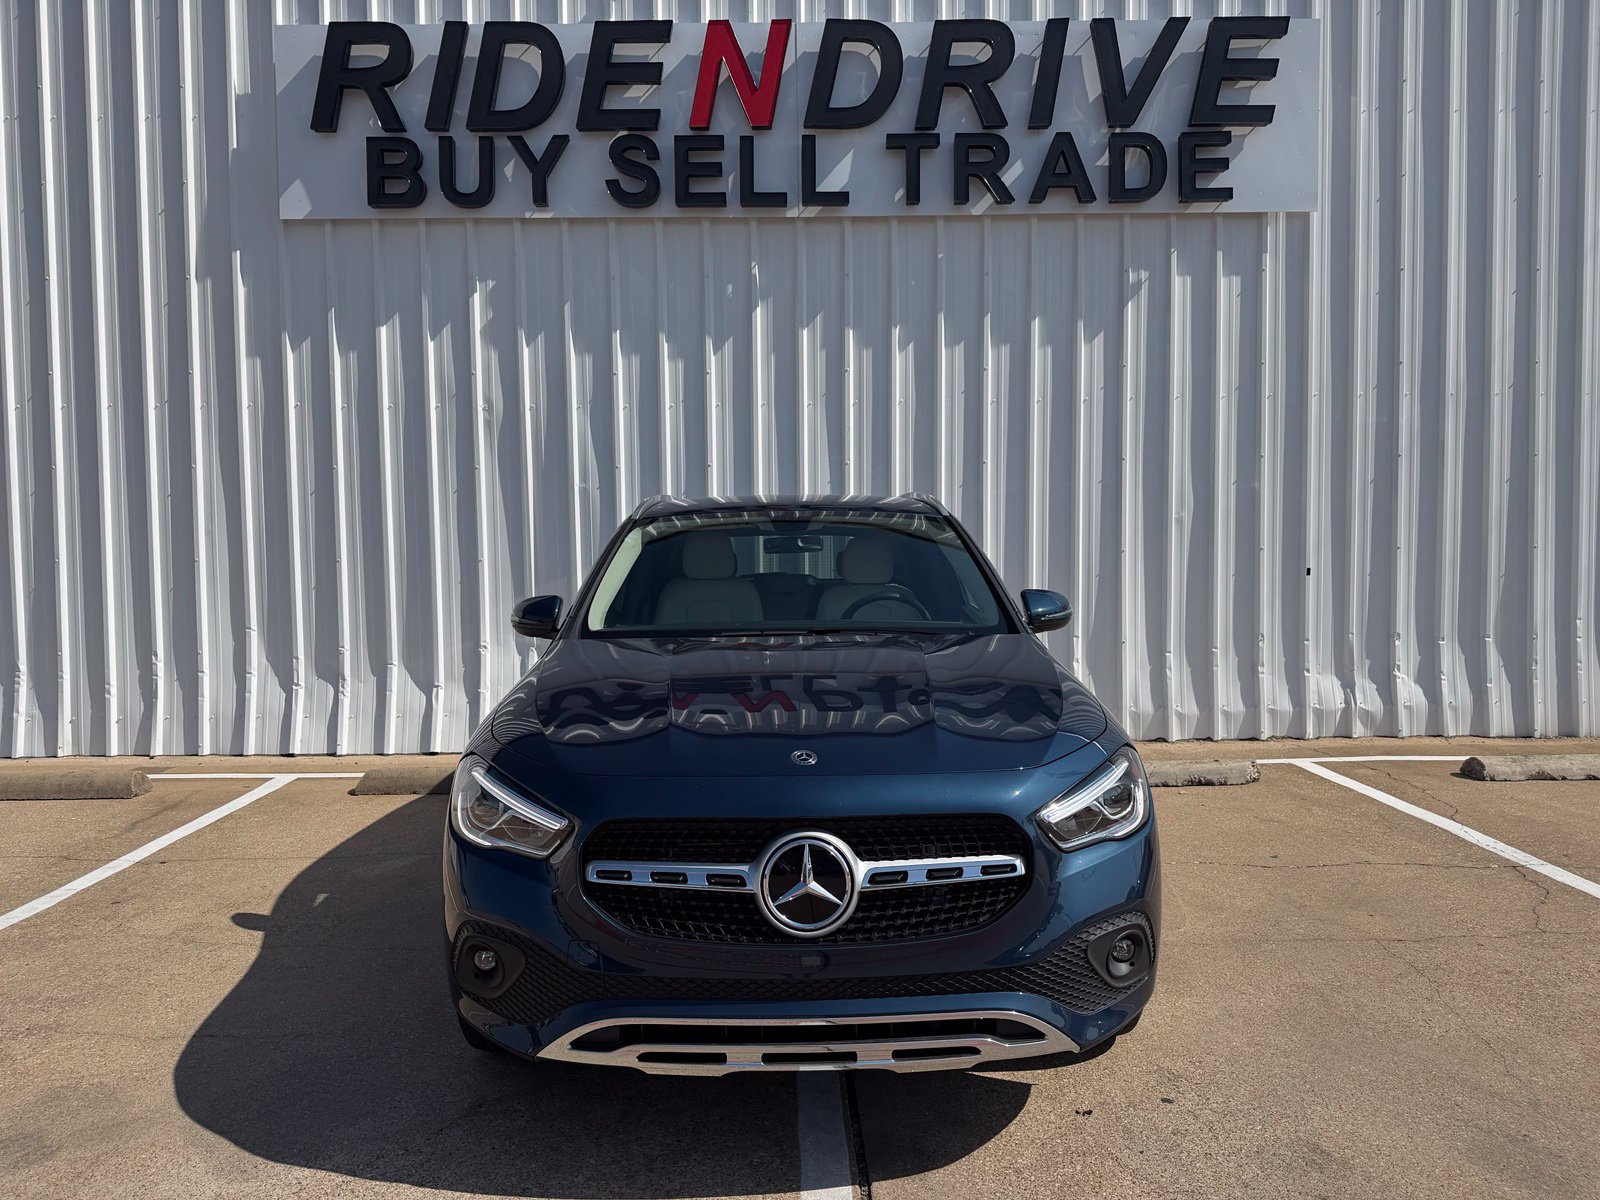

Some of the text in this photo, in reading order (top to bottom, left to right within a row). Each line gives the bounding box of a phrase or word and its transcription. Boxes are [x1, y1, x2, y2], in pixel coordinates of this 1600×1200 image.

[366, 131, 1234, 209] BUY SELL TRADE
